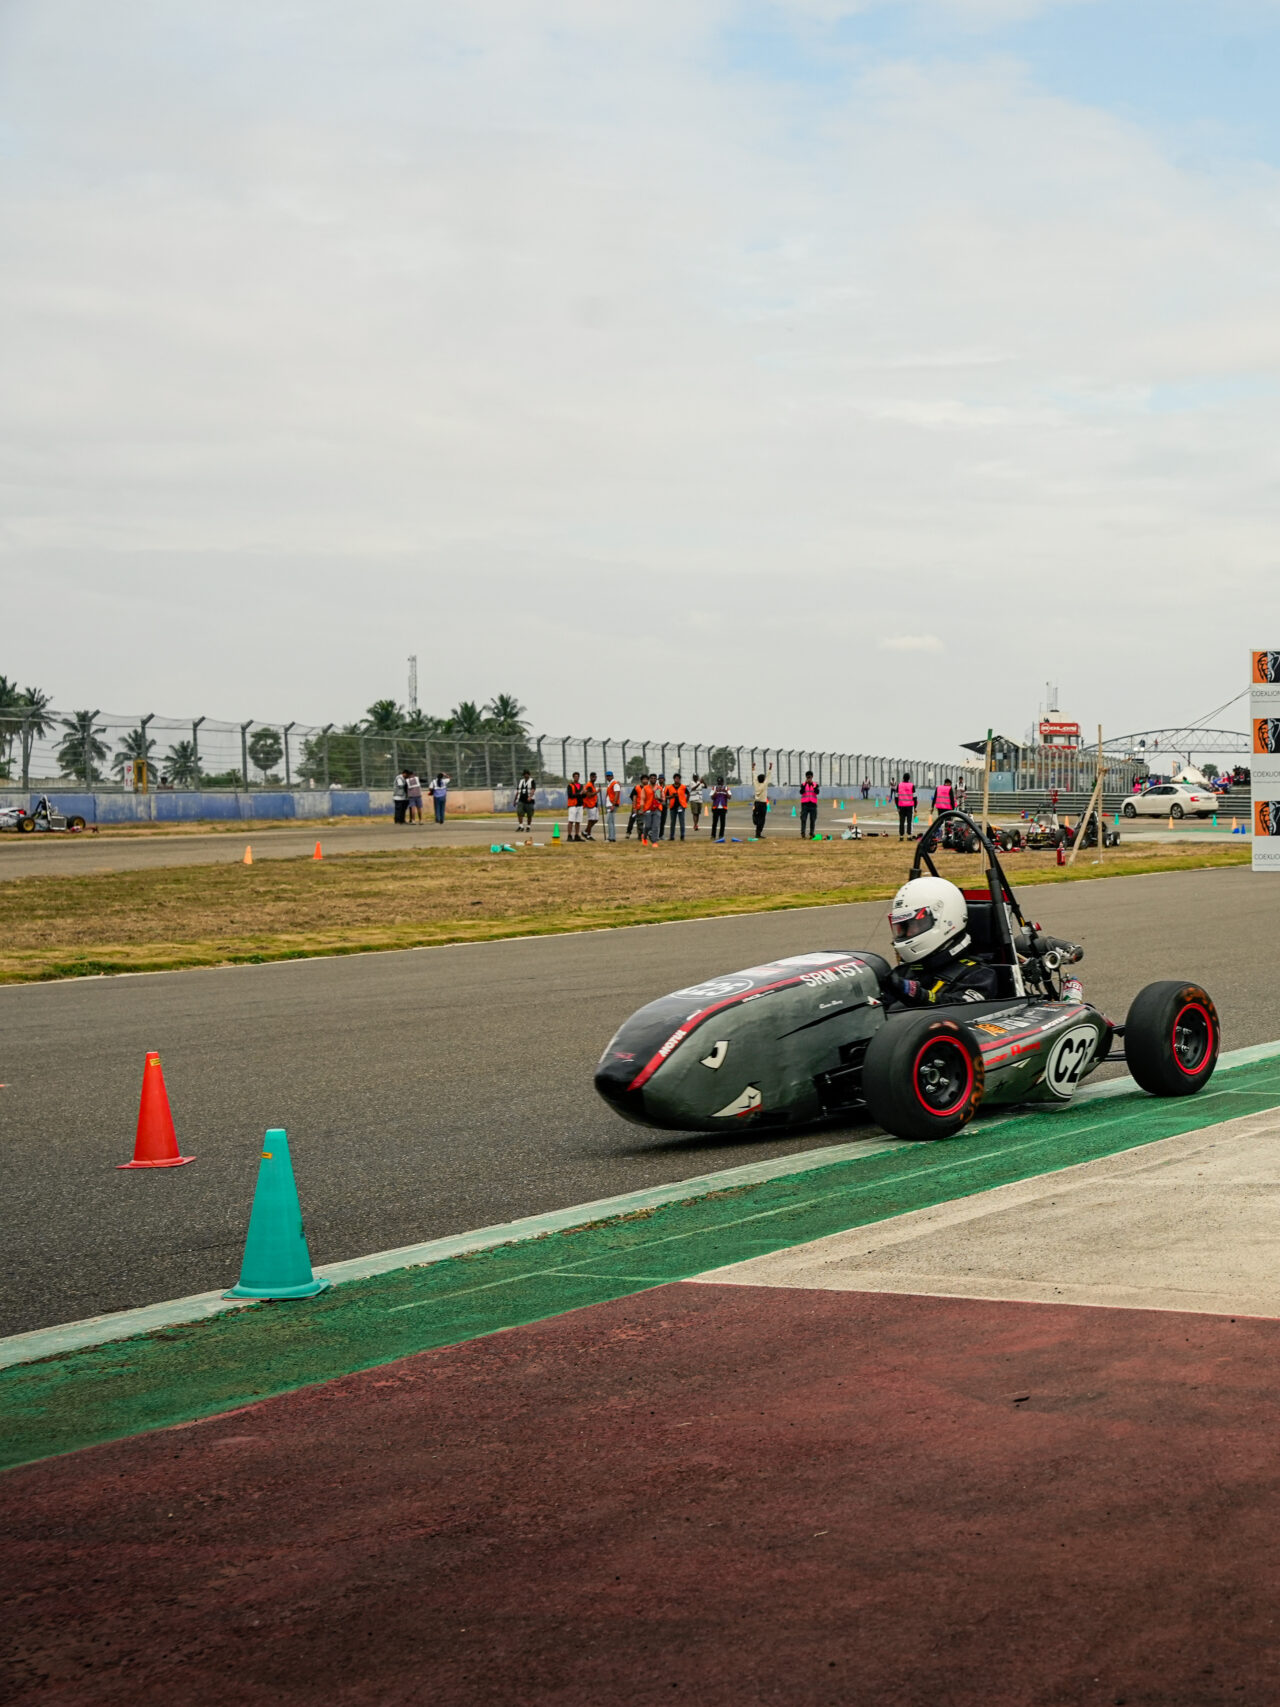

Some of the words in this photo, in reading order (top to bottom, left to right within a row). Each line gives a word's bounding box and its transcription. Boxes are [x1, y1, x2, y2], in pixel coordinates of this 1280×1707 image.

[800, 969, 840, 987] SRM
[833, 962, 864, 978] IST
[658, 1029, 688, 1057] MOTUL
